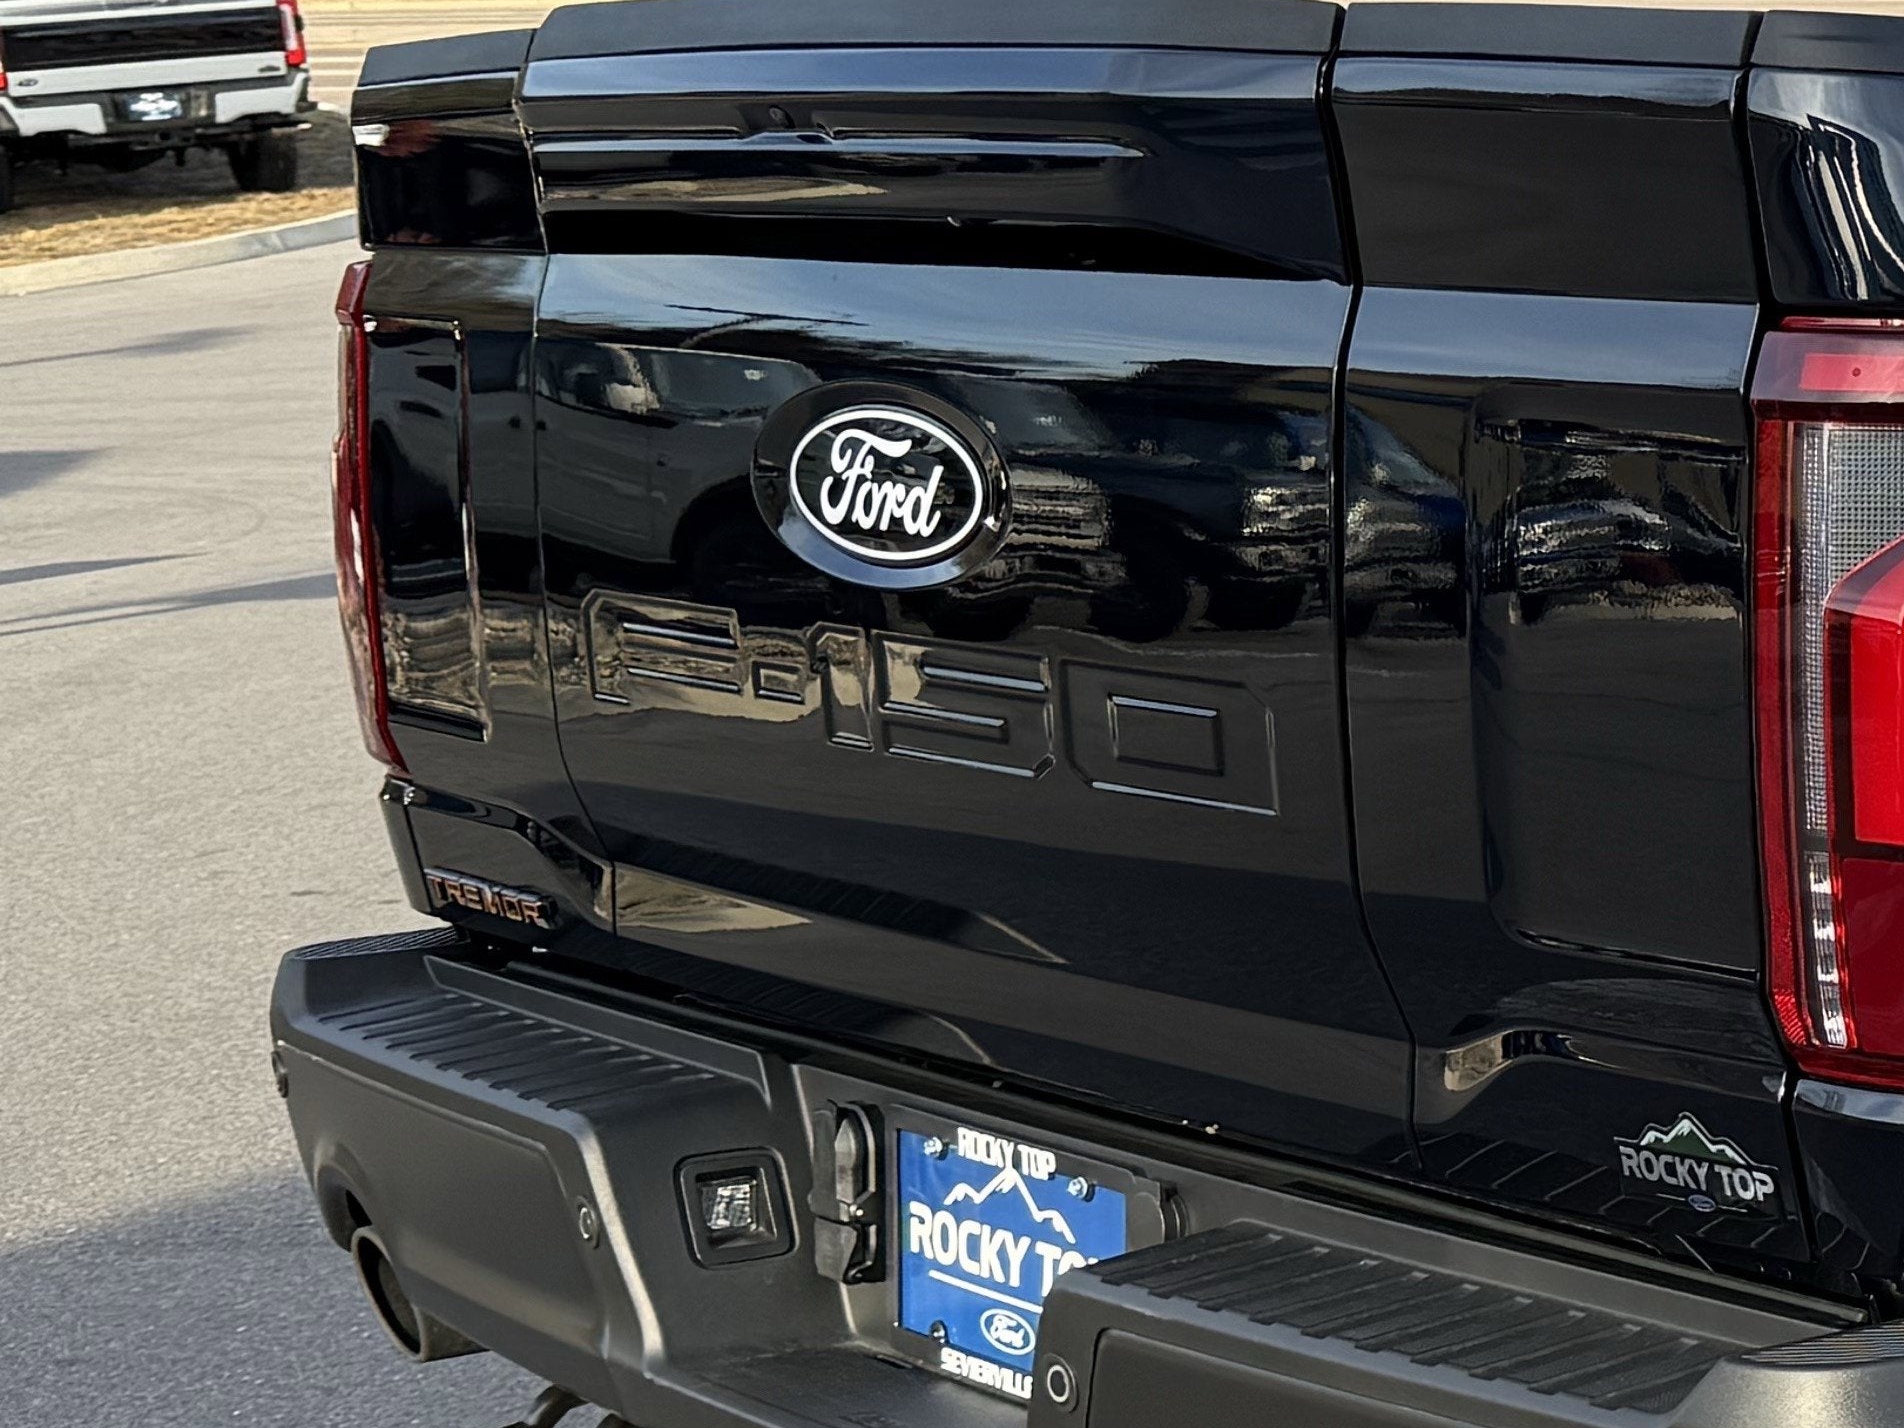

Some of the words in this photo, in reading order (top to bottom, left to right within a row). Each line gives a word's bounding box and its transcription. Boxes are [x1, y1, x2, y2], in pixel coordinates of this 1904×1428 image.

[819, 428, 945, 538] Ford
[580, 588, 1280, 816] F-150
[425, 871, 551, 930] TREMOR
[957, 1127, 1014, 1169] ROCKY
[1017, 1144, 1057, 1181] TOP
[1619, 1145, 1710, 1192] ROCKY
[1714, 1163, 1775, 1202] TOP
[909, 1200, 1031, 1288] ROCKY
